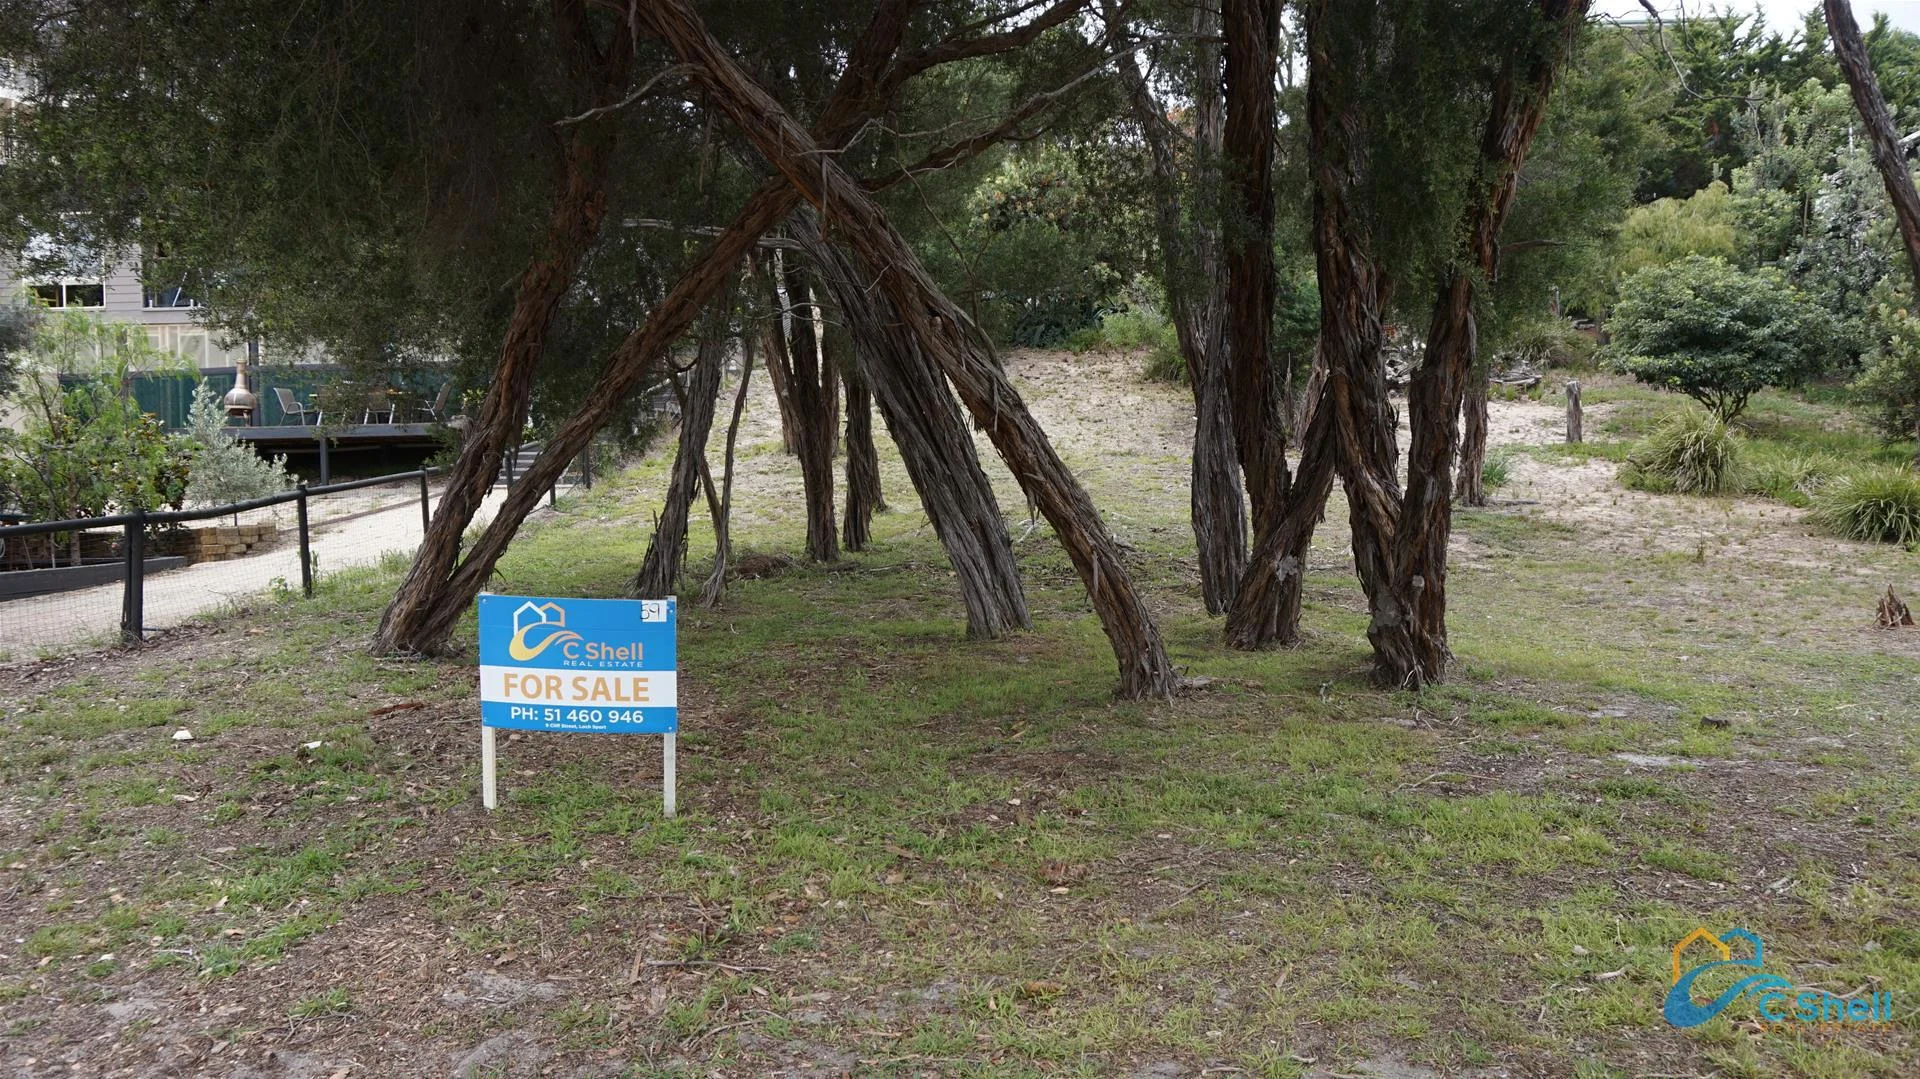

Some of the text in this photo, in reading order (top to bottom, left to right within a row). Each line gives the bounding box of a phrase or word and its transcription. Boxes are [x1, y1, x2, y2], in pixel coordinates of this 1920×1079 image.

[563, 642, 644, 660] C Shell
[503, 673, 649, 702] FOR SALE
[511, 706, 644, 724] PH: 51 460 946
